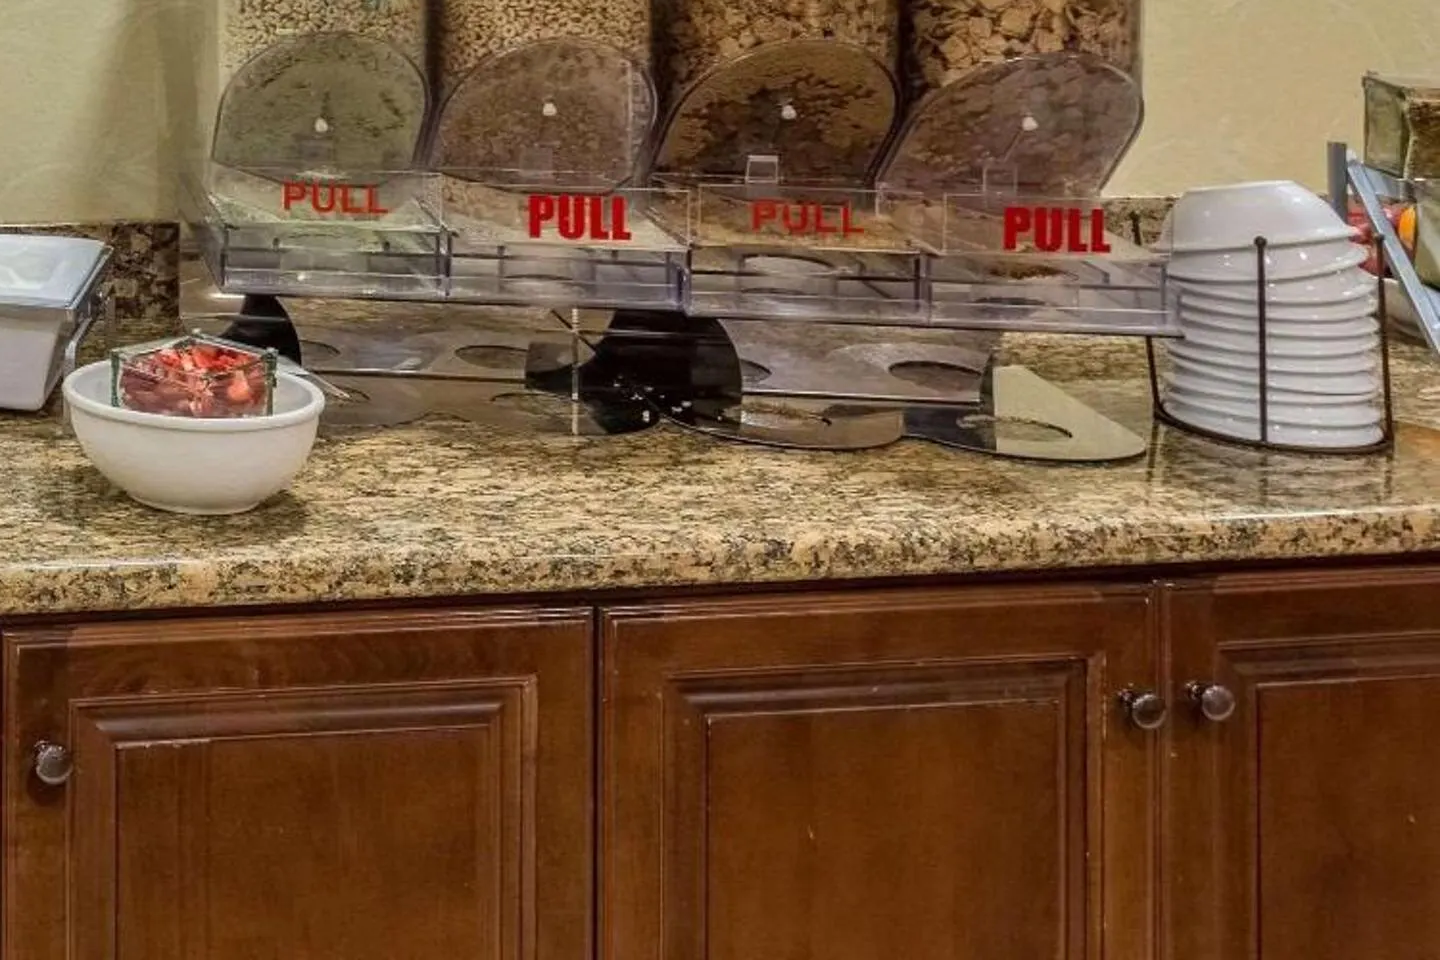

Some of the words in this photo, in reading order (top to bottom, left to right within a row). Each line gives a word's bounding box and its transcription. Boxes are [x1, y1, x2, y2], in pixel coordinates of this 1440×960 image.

[283, 182, 388, 213] PULL
[528, 194, 632, 240] PULL
[750, 200, 864, 237] PULL
[1003, 206, 1111, 253] PULL
